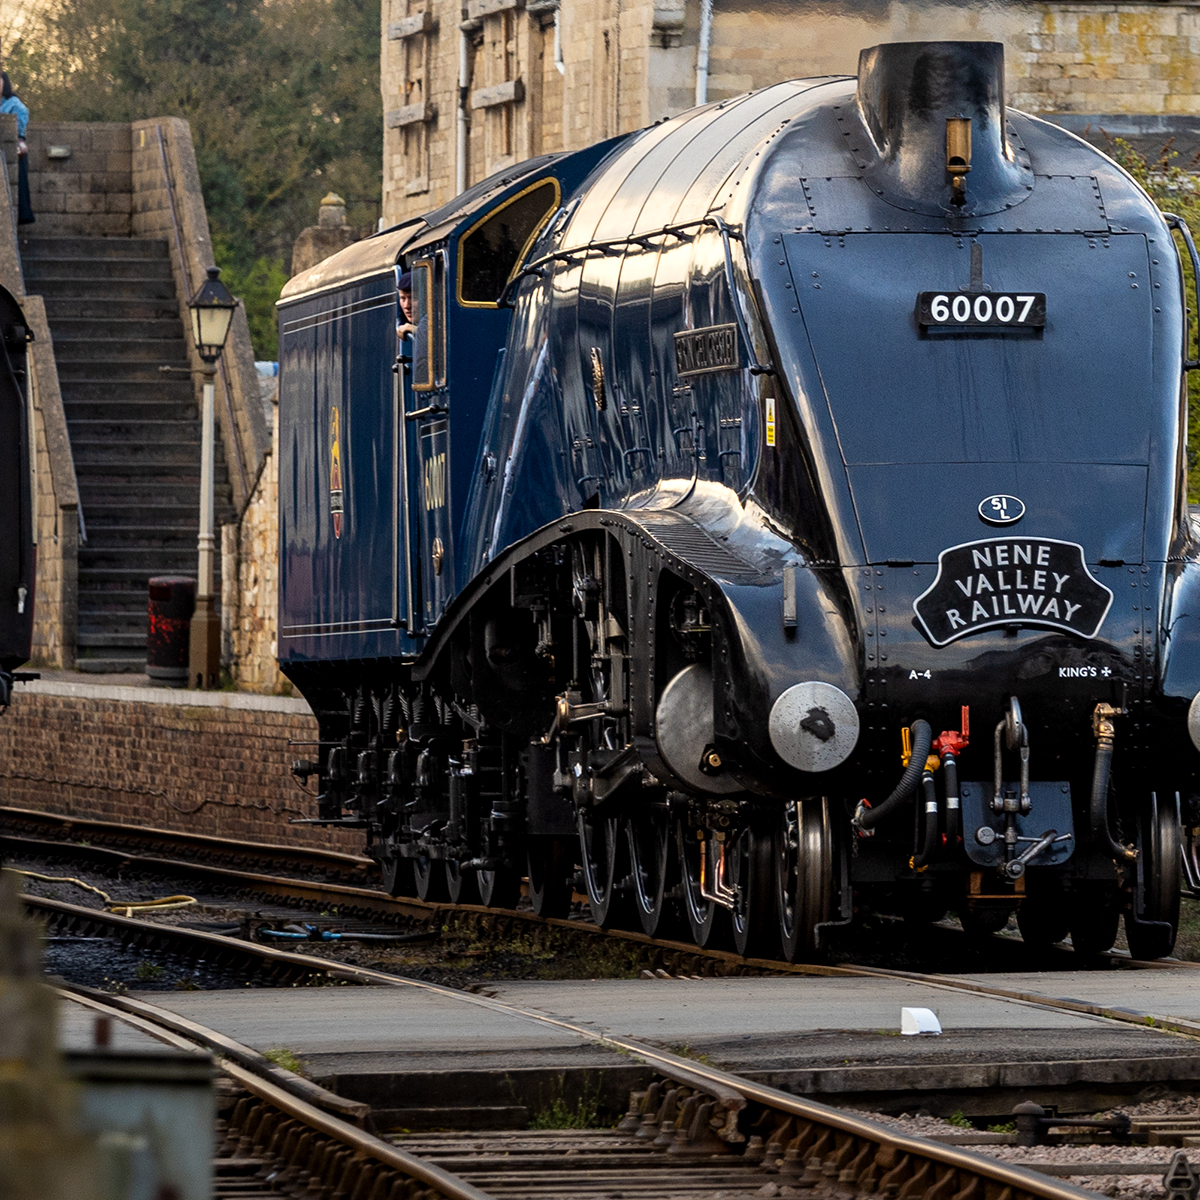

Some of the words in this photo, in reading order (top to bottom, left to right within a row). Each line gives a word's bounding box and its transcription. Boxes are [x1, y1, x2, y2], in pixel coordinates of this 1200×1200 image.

[931, 294, 1036, 322] 60007
[972, 544, 1051, 570] NENE
[955, 569, 1070, 598] VALLEY
[946, 593, 1082, 630] RAILWAY
[908, 669, 932, 680] A-4
[1058, 665, 1097, 678] KING'S
